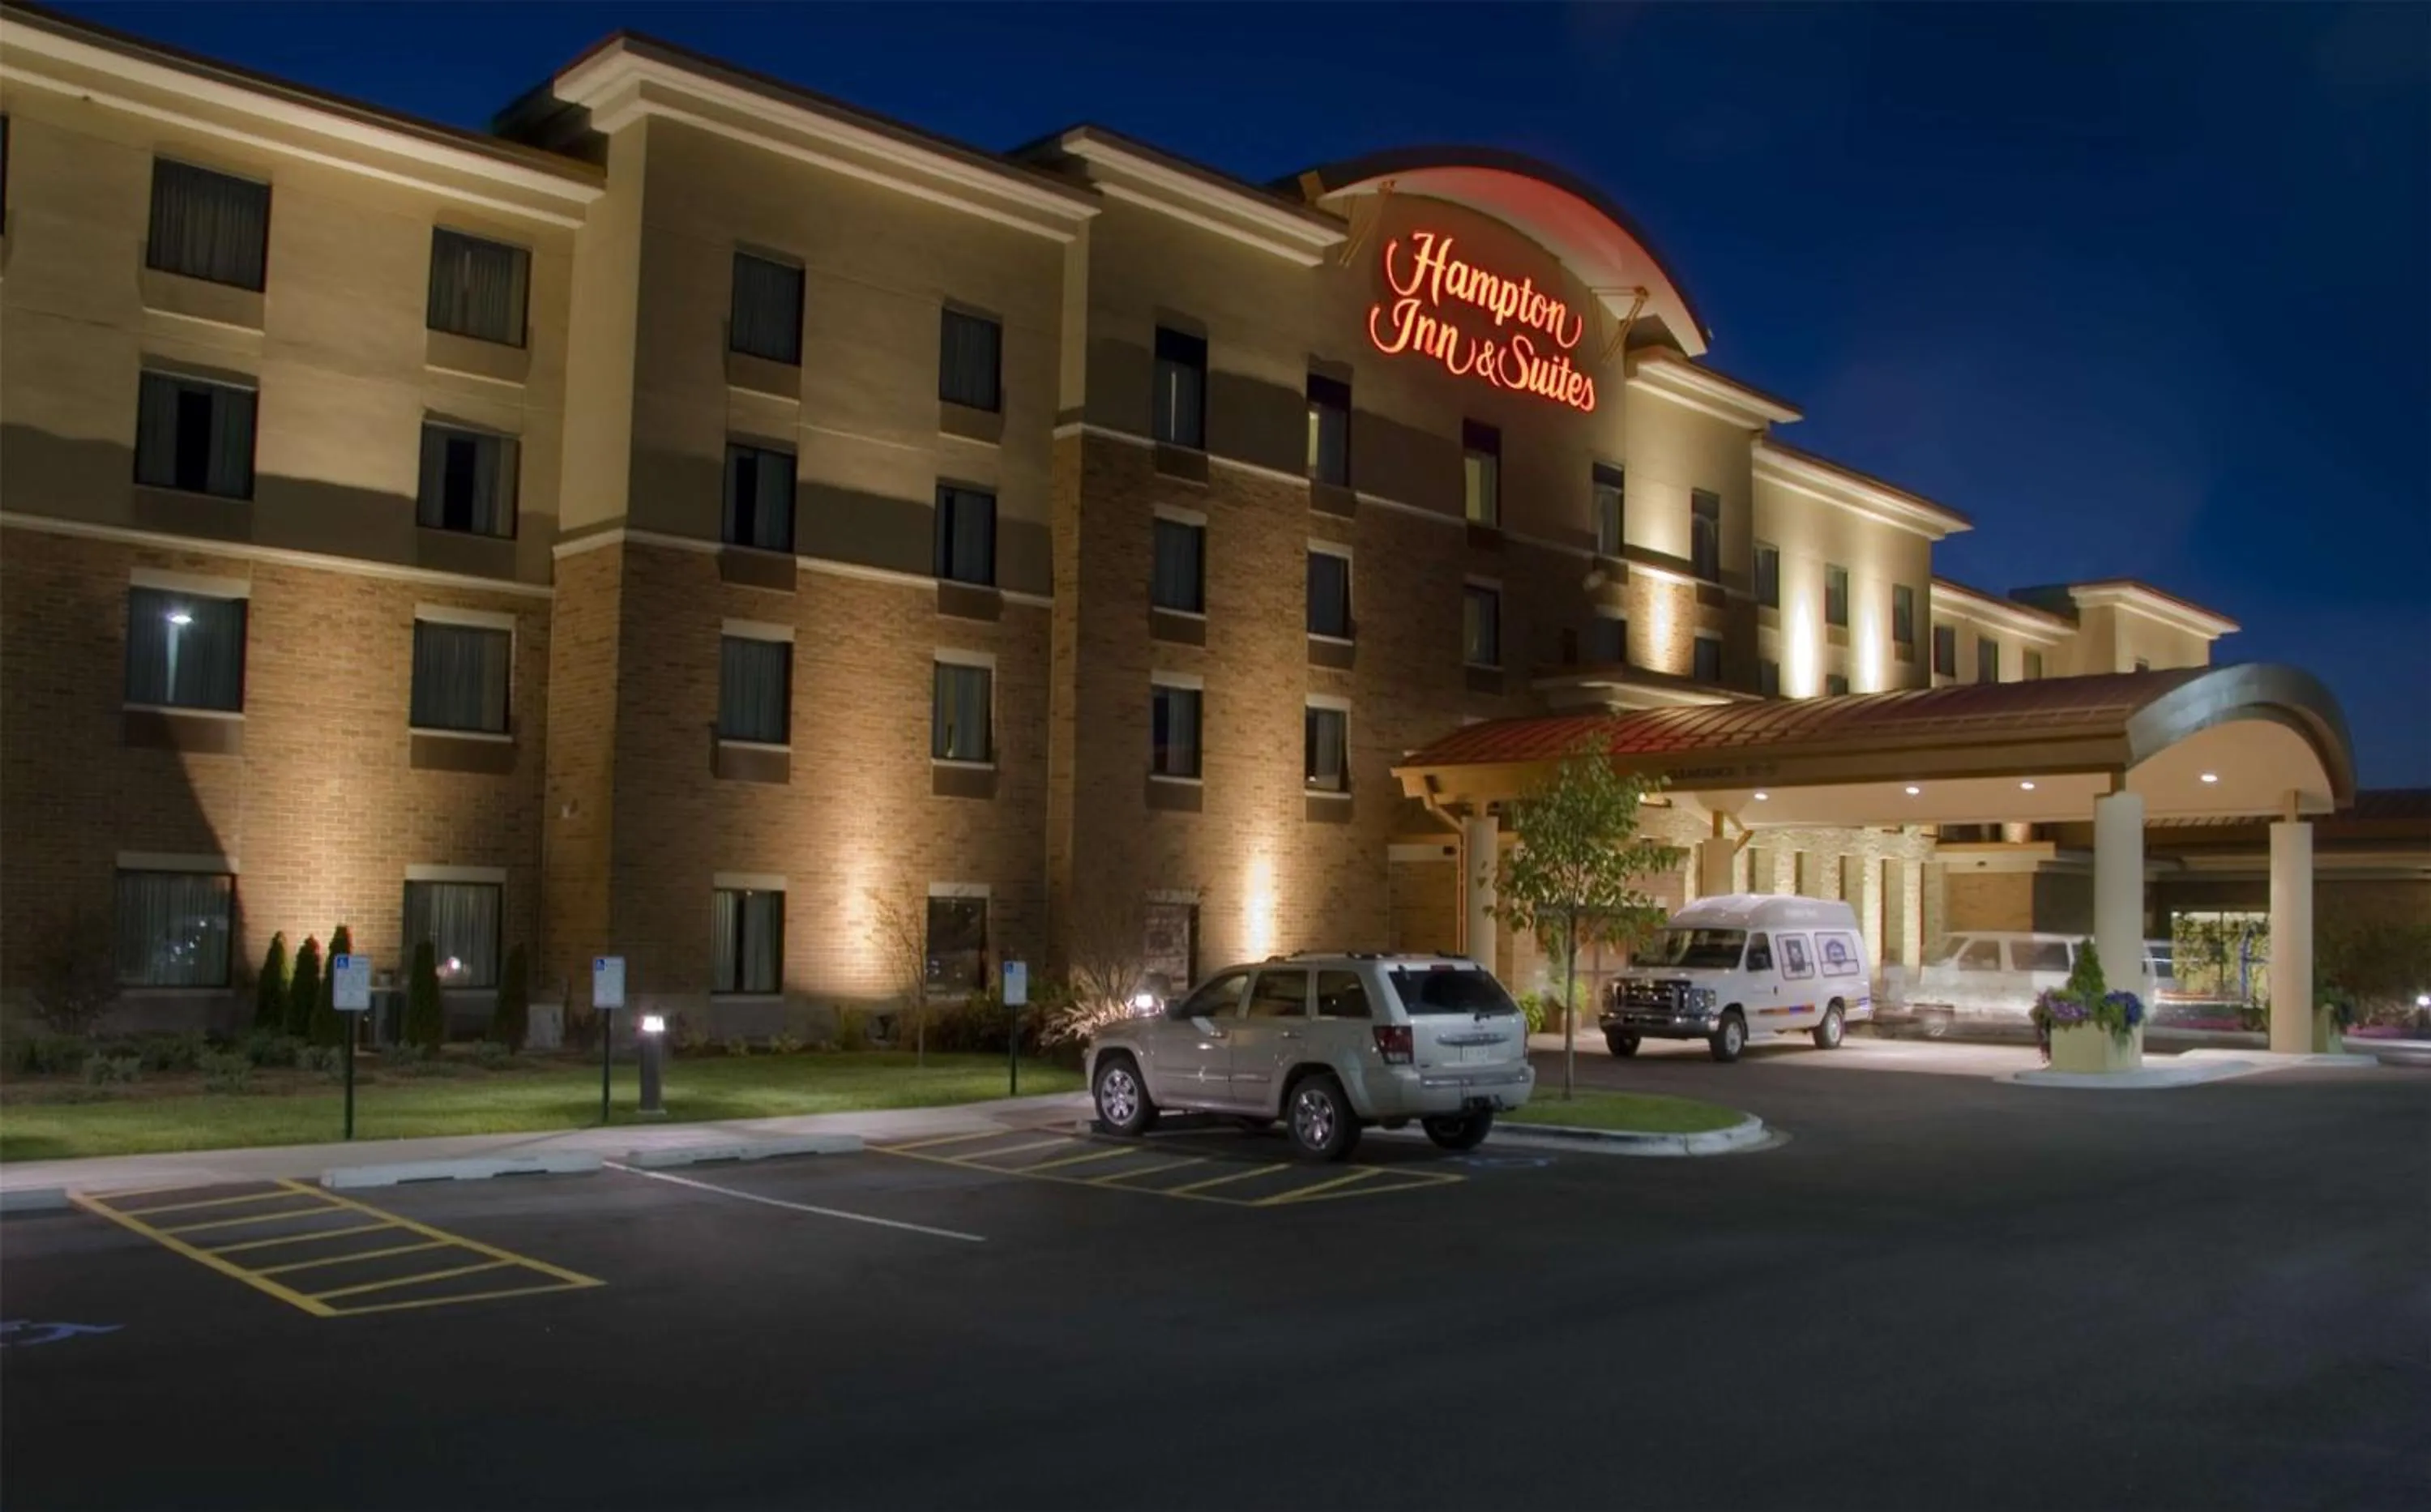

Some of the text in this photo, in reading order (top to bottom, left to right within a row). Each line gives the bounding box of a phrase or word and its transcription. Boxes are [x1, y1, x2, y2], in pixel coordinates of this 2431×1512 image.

[1386, 232, 1583, 348] Hampton
[1369, 298, 1596, 412] Inn & Suites
